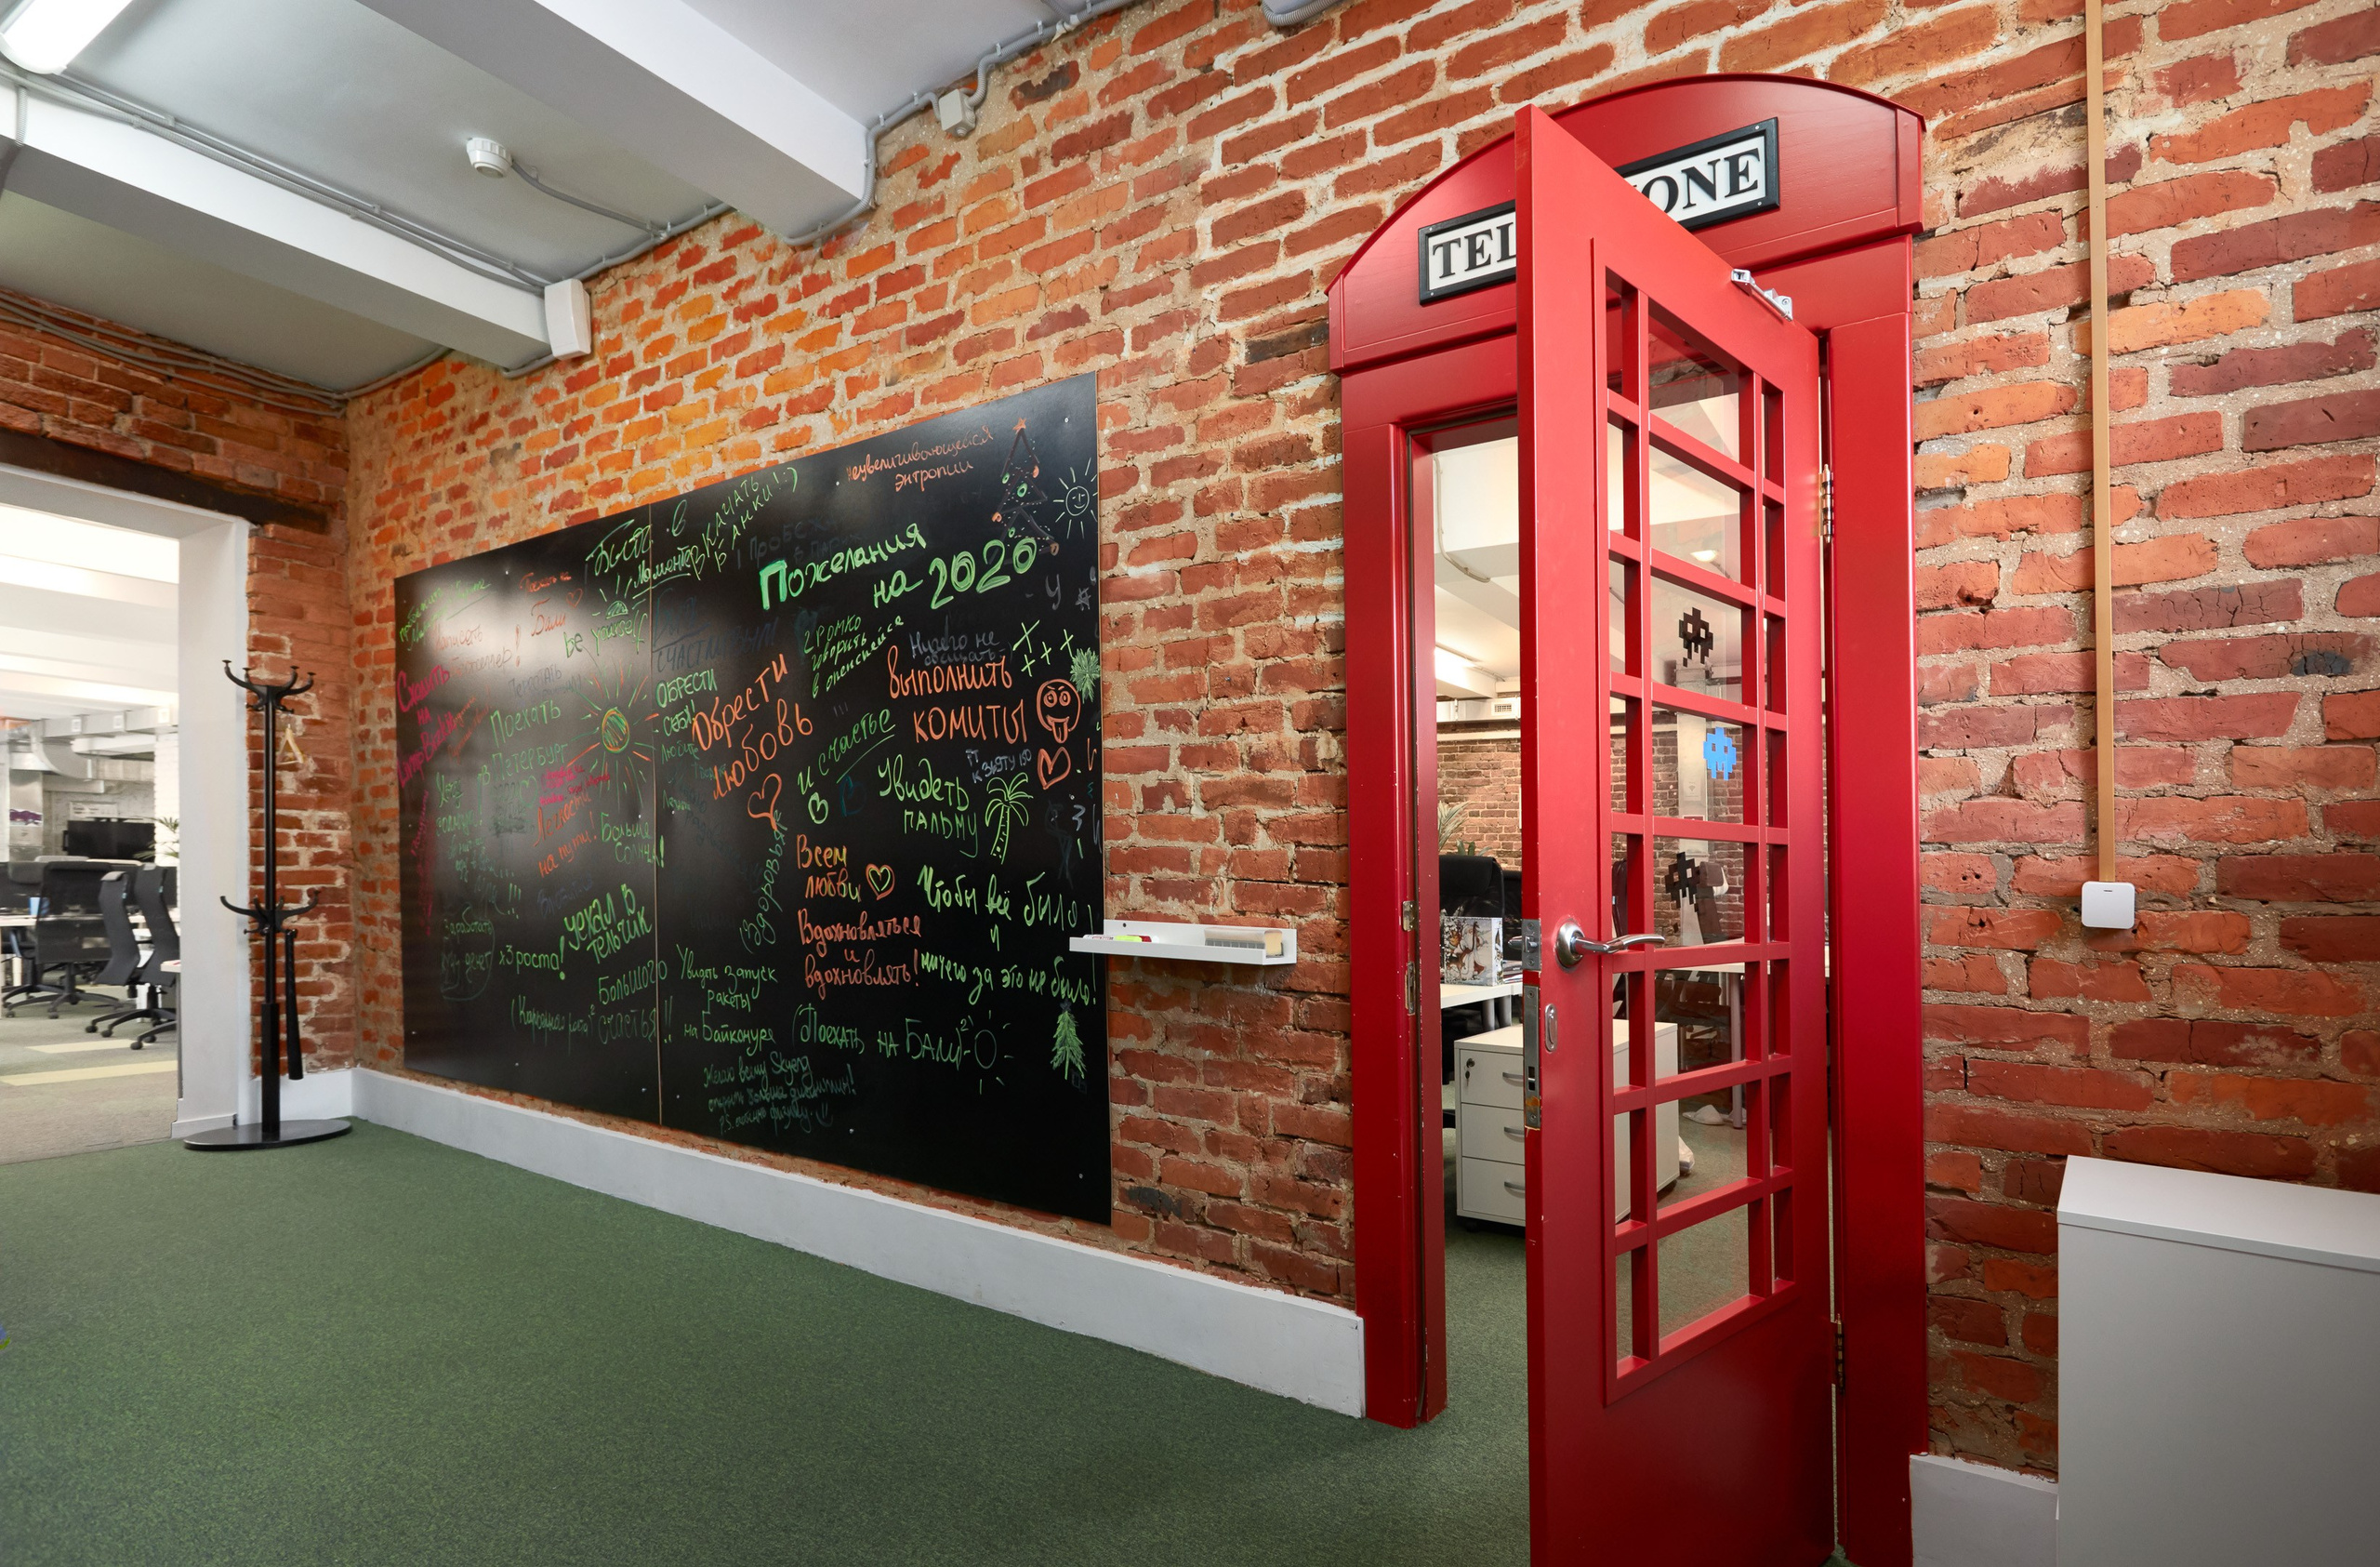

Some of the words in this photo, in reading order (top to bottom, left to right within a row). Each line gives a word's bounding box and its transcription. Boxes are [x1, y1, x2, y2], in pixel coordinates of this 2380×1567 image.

[895, 460, 973, 492] энтропии
[759, 523, 928, 611] Пожелания
[873, 569, 923, 608] на
[930, 537, 1038, 609] 2020
[563, 631, 584, 658] be
[591, 609, 648, 656] yourself
[974, 631, 1001, 649] не
[654, 668, 718, 709] ОБРЕСТИ
[796, 833, 848, 870] Всем
[805, 867, 863, 904] любви
[598, 959, 668, 1005] Большого
[968, 966, 995, 1006] за
[1000, 963, 1024, 989] это
[1028, 967, 1048, 996] не
[683, 1023, 698, 1040] на
[702, 1010, 777, 1057] Байконуре
